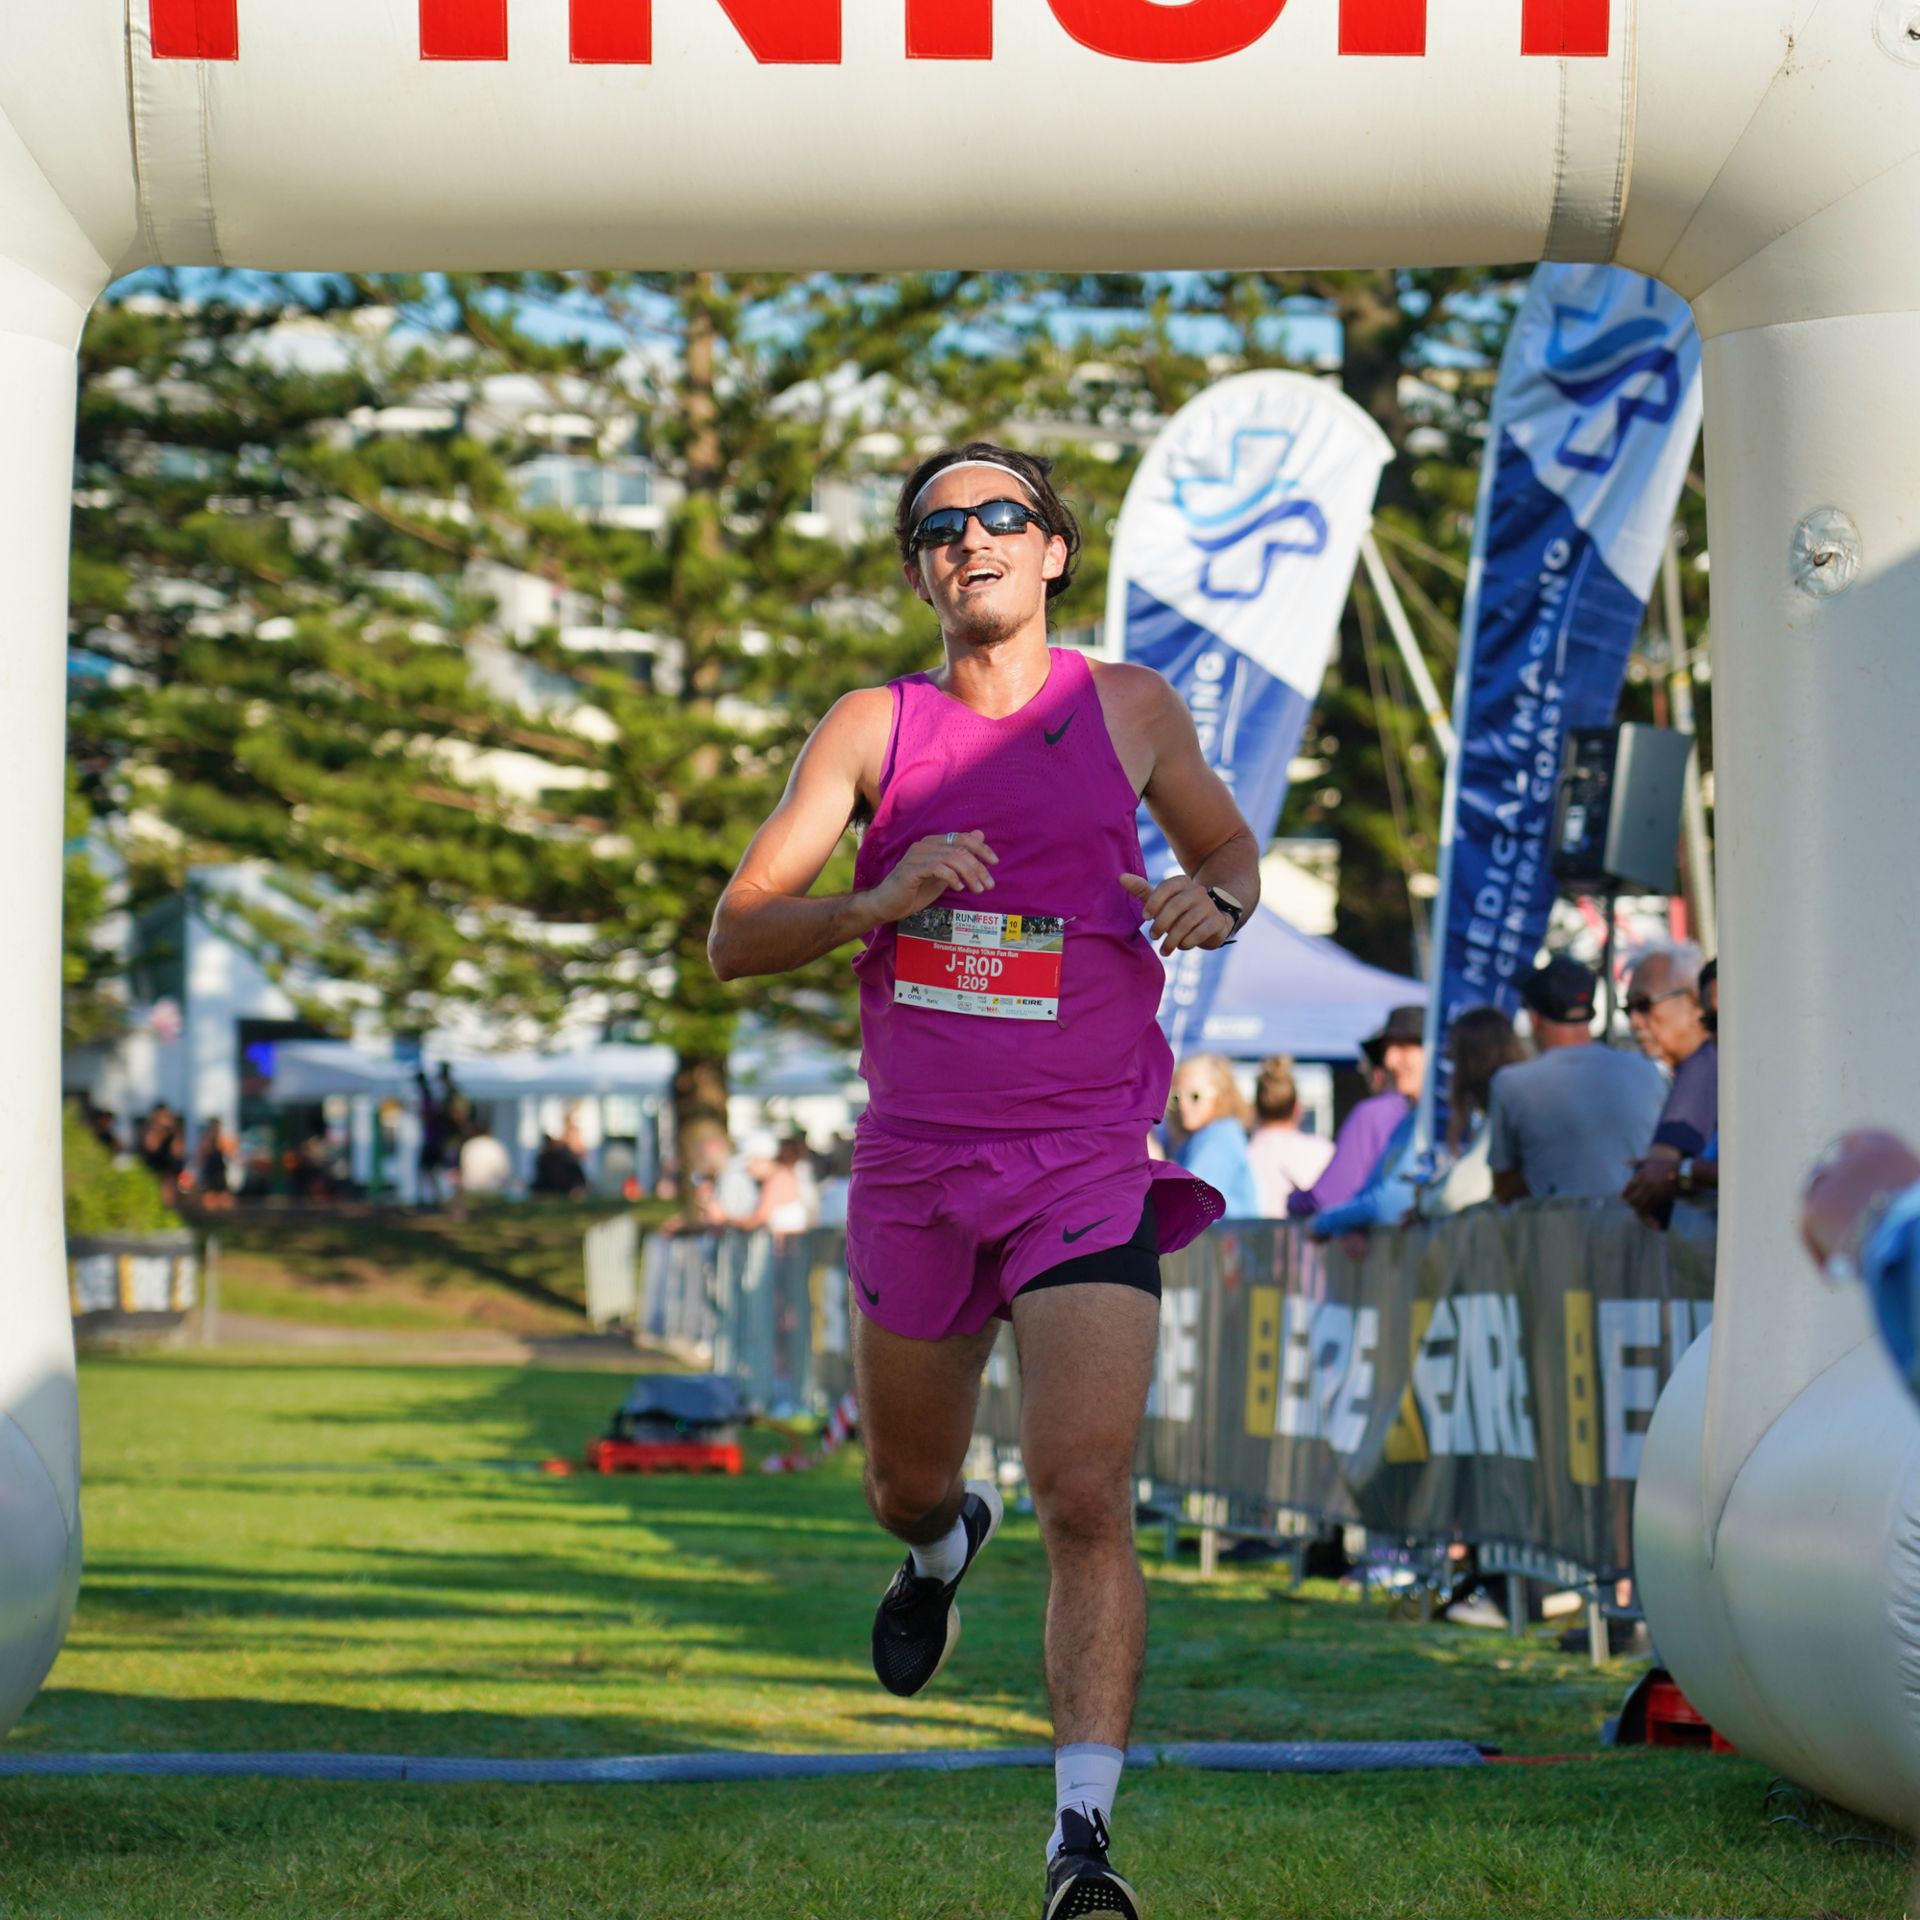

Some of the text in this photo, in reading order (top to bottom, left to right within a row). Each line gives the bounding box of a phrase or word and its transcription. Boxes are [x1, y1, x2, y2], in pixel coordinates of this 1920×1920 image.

[1461, 537, 1571, 987] MEDICAL IMAGING
[1494, 679, 1564, 978] CENTRAL COAST
[1009, 920, 1018, 929] 10
[945, 953, 1003, 977] J-ROD
[956, 974, 988, 991] 1209
